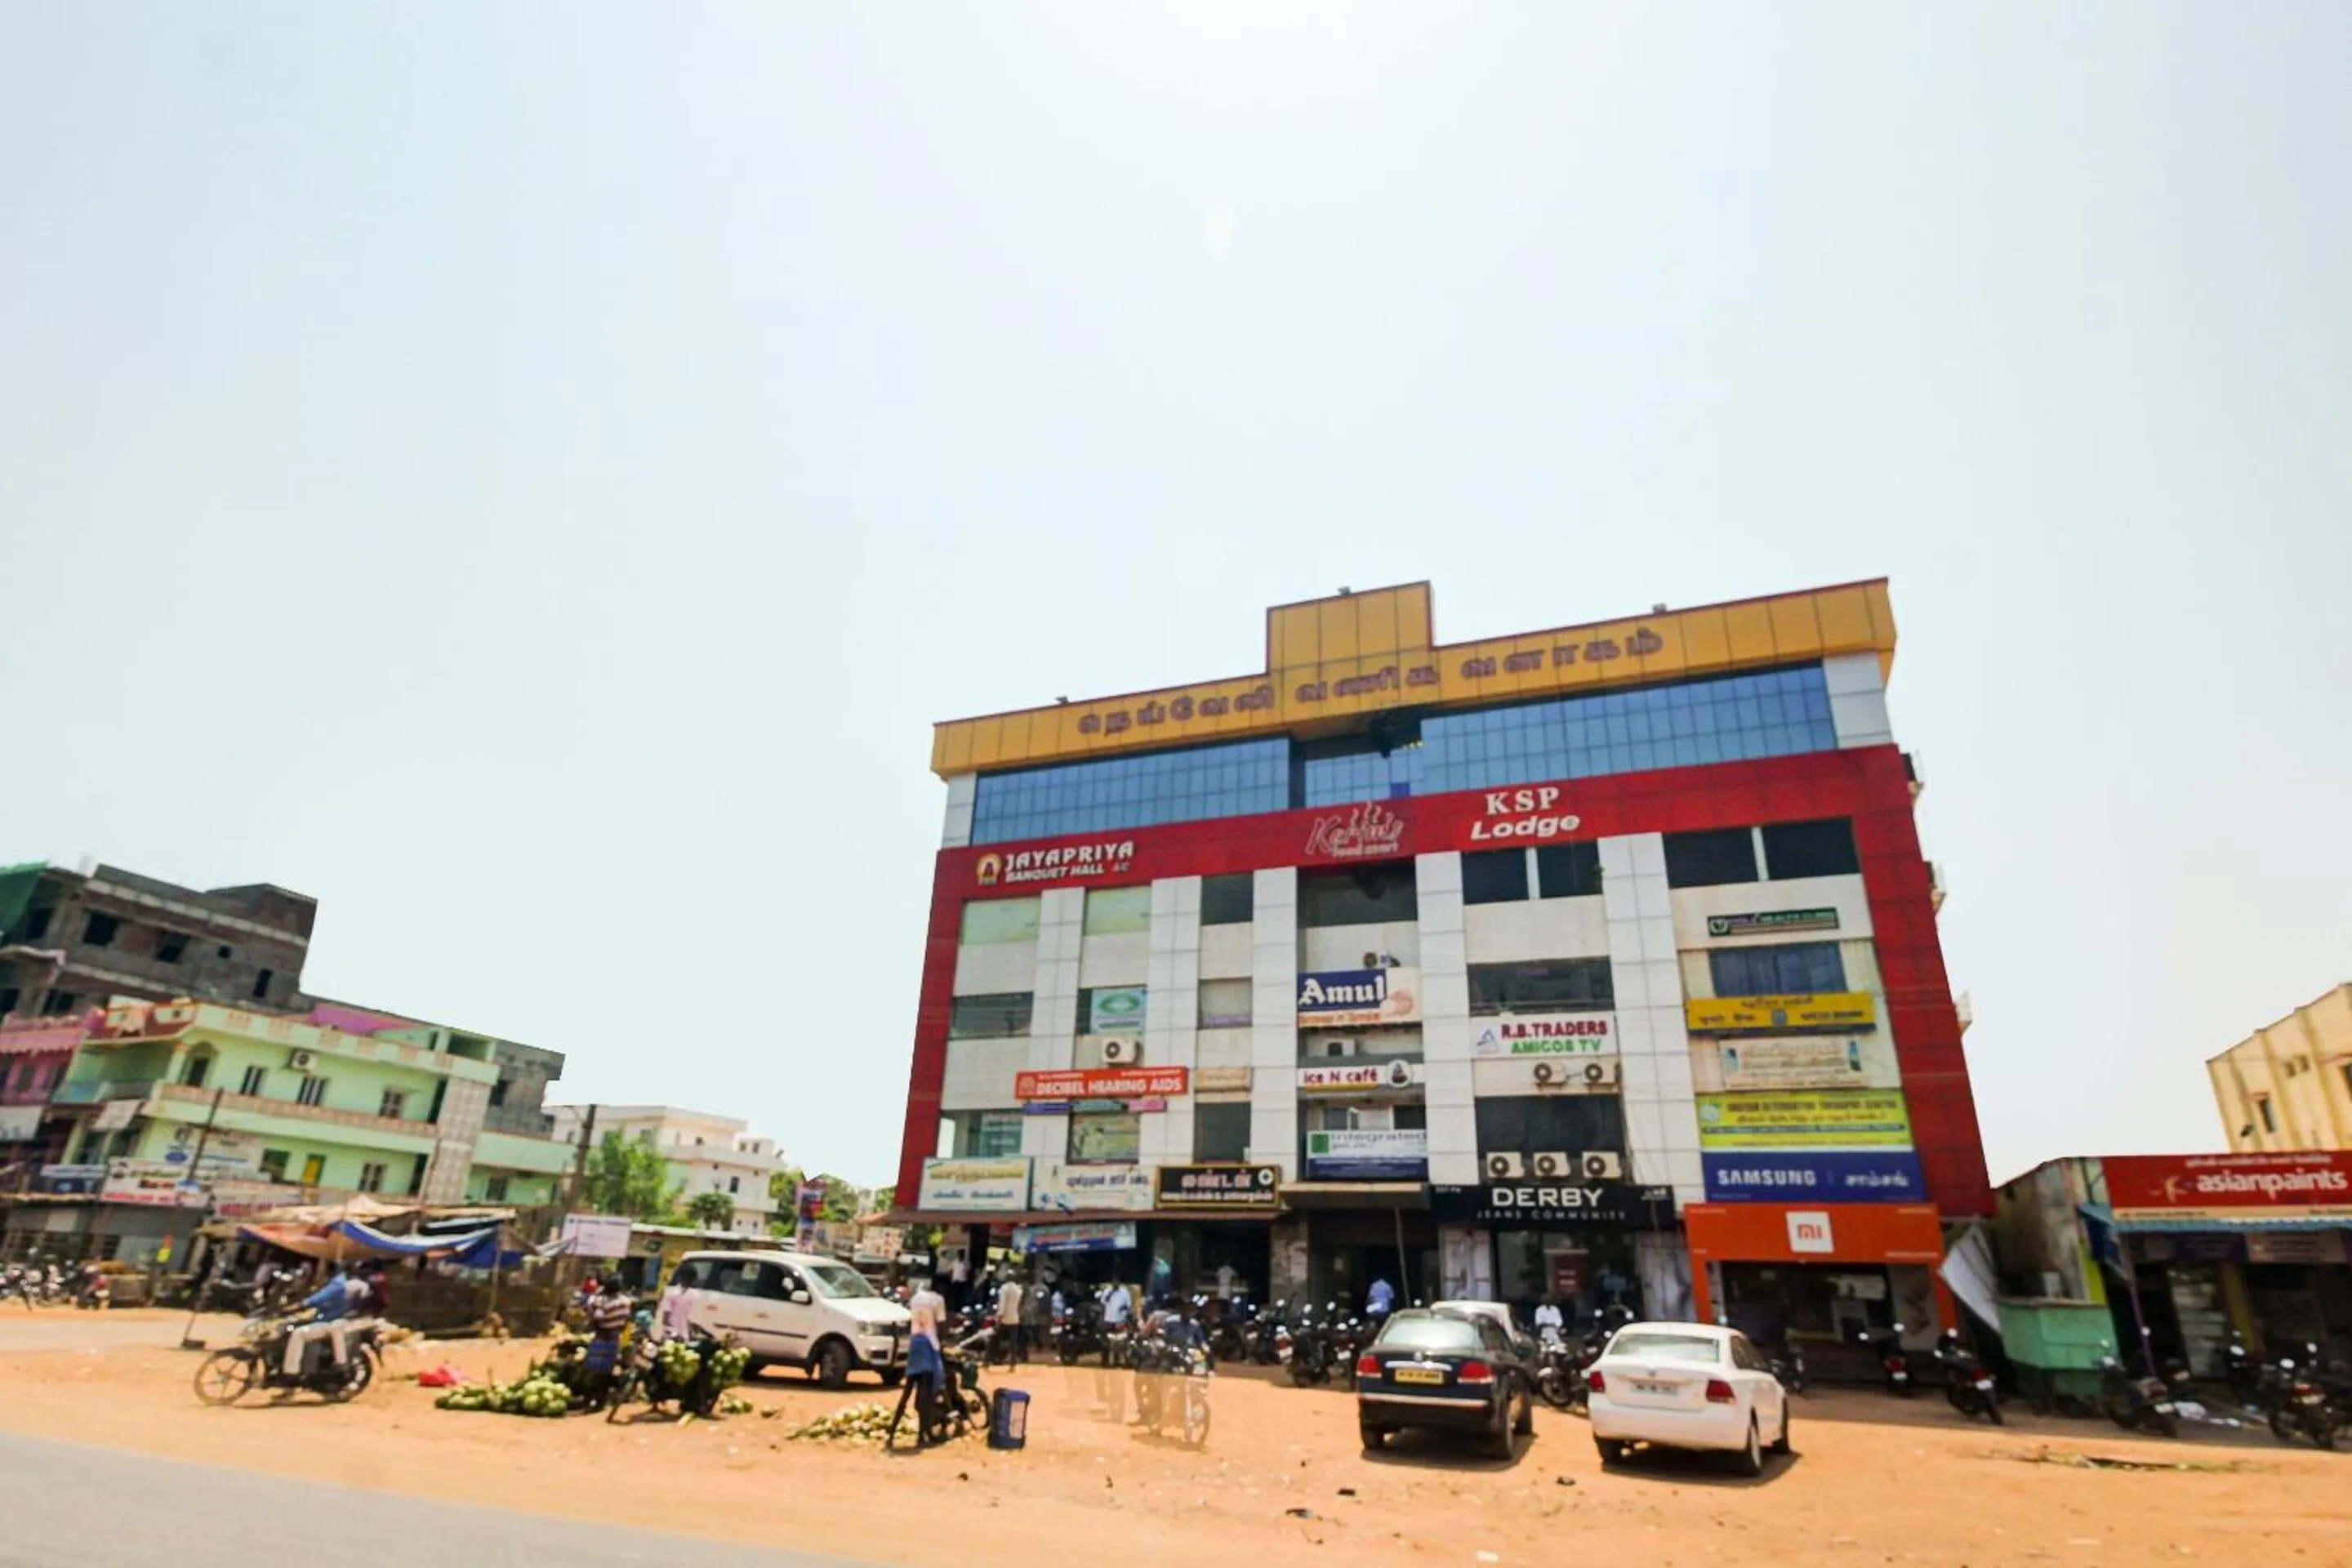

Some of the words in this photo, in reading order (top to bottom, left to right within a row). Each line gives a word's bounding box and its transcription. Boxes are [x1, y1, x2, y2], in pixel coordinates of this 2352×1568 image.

[1486, 786, 1560, 816] KSP
[1470, 814, 1580, 841] Lodge
[1004, 840, 1135, 871] JAYAPRIYA
[1004, 866, 1067, 884] BANQUET
[1070, 862, 1104, 877] HALL
[1298, 975, 1385, 1005] Amul
[1578, 1037, 1602, 1053] TV
[1088, 1078, 1147, 1094] HEARING
[1149, 1076, 1183, 1092] AIDS
[1717, 1169, 1817, 1186] SAMSUNG
[1491, 1187, 1604, 1207] DERBY
[1477, 1209, 1522, 1219] JEANS
[1531, 1209, 1626, 1221] COMMUNITY
